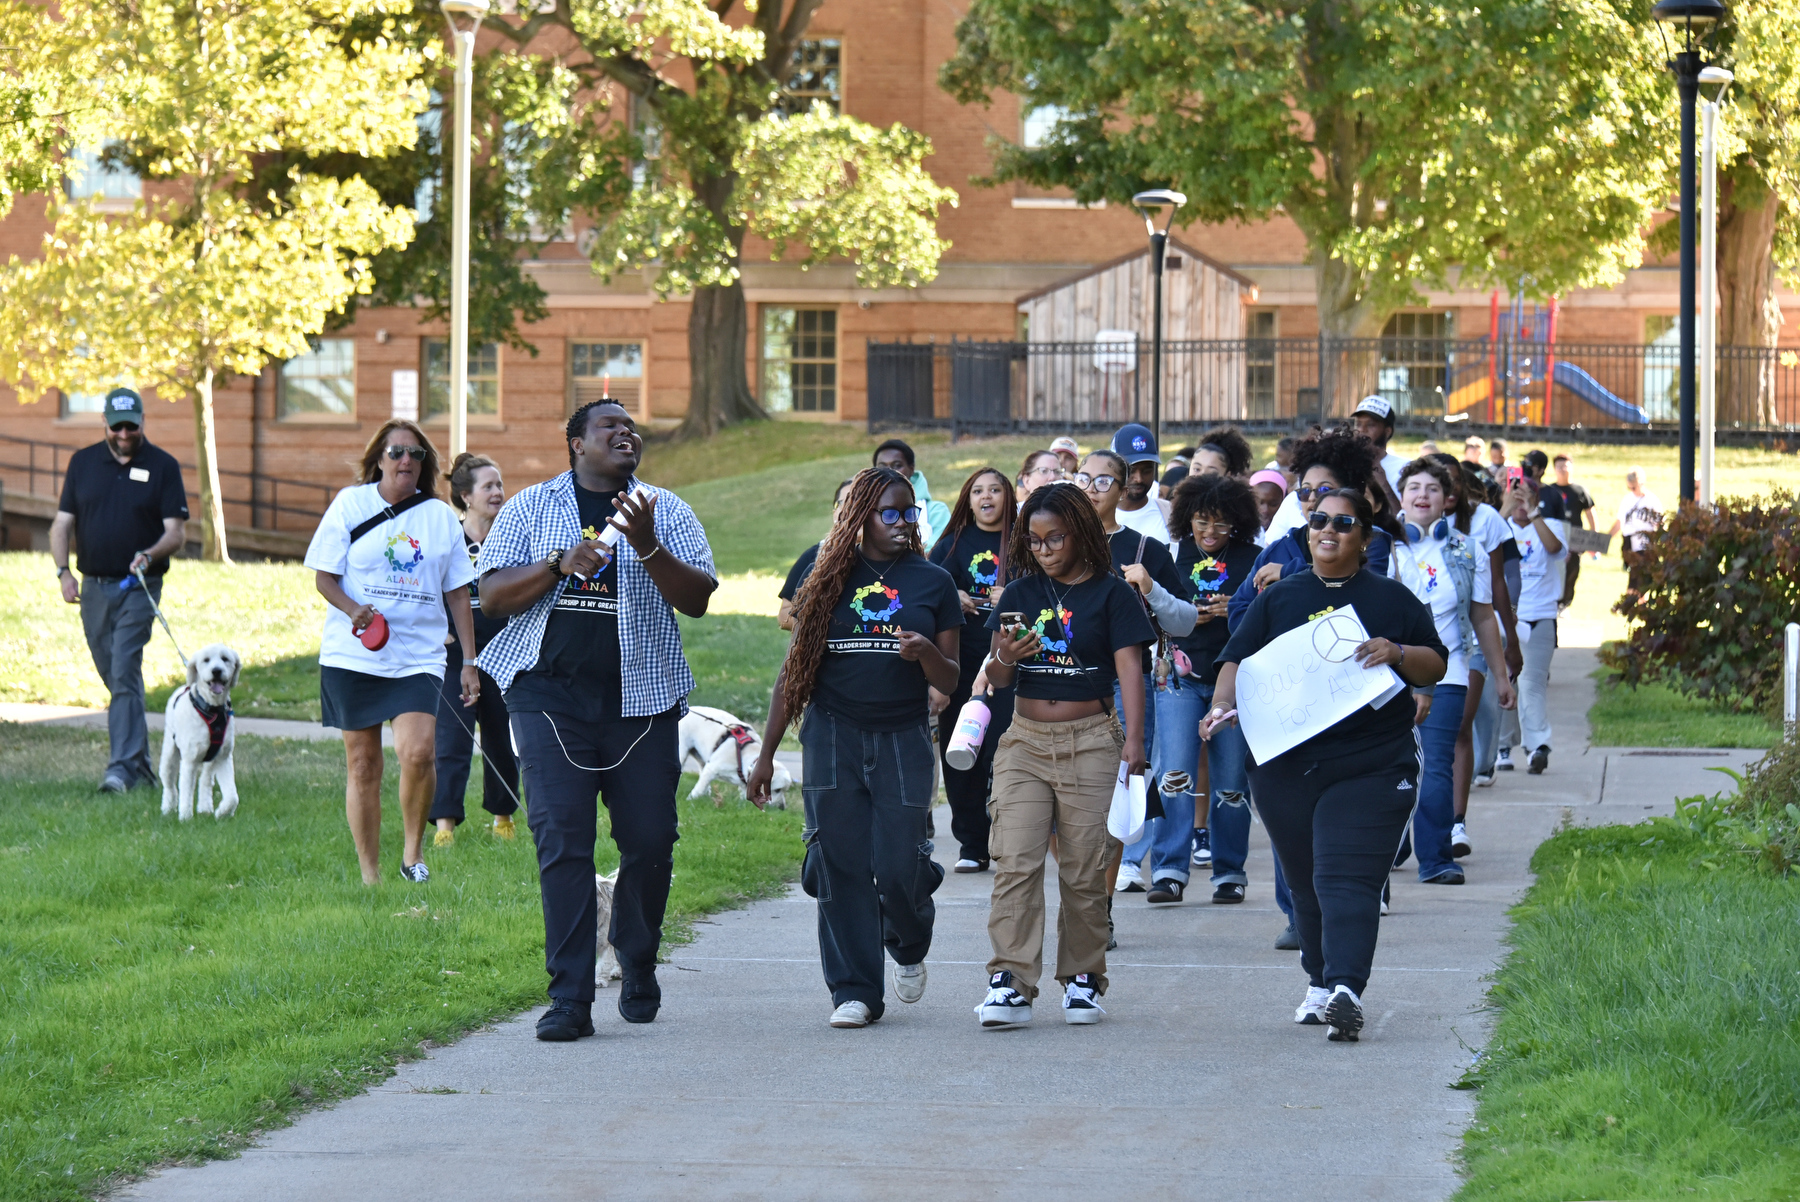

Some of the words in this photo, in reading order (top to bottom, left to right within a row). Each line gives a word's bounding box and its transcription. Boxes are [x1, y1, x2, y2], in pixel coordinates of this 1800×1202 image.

[386, 575, 419, 586] ALANA
[567, 580, 609, 593] ALANA
[969, 585, 993, 595] ALAN
[371, 589, 399, 597] LEADERSHIP
[597, 602, 618, 610] GREAT
[852, 624, 903, 634] ALANA
[836, 642, 872, 650] LEADERSHIP
[1033, 653, 1074, 666] ALANA
[1238, 652, 1322, 717] Peace
[1275, 699, 1318, 736] For
